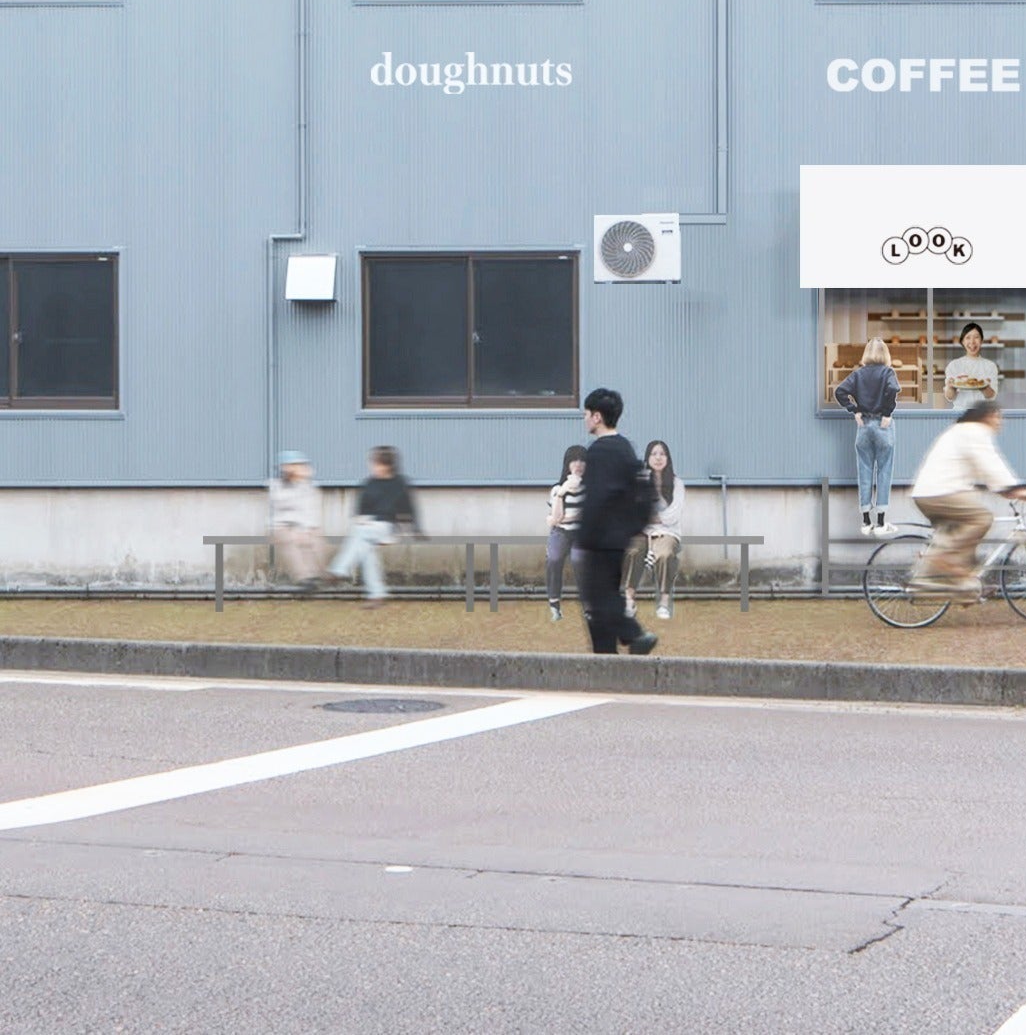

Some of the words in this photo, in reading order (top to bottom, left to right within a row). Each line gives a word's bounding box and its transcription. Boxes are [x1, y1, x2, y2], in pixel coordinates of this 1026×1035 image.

[371, 51, 573, 94] doughnuts
[826, 58, 1021, 92] COFFEE
[889, 231, 966, 259] LOOK
